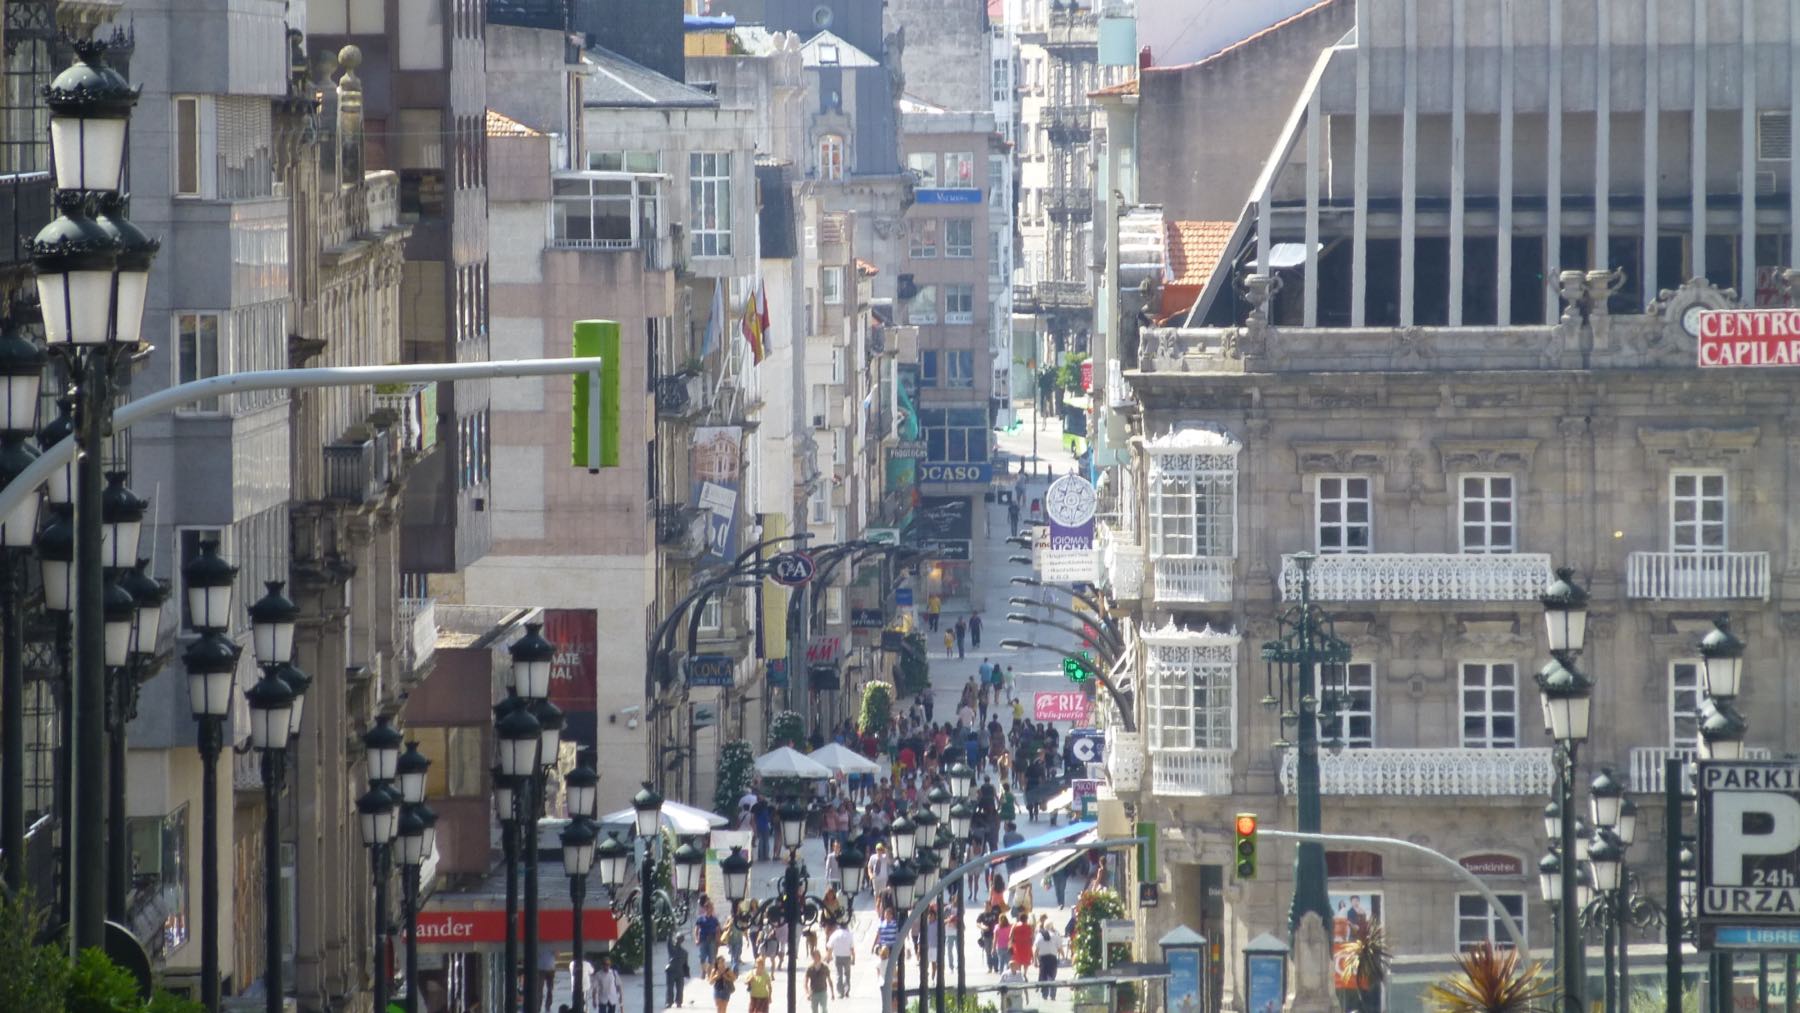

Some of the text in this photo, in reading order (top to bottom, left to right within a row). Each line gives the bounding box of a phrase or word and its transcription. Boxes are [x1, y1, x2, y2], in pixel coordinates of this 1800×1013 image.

[1707, 769, 1800, 788] PARKI
[1713, 792, 1800, 886] P
[1753, 869, 1794, 886] 24h
[1708, 890, 1800, 912] URZA
[415, 917, 474, 937] ander
[1747, 929, 1800, 943] LIBRE
